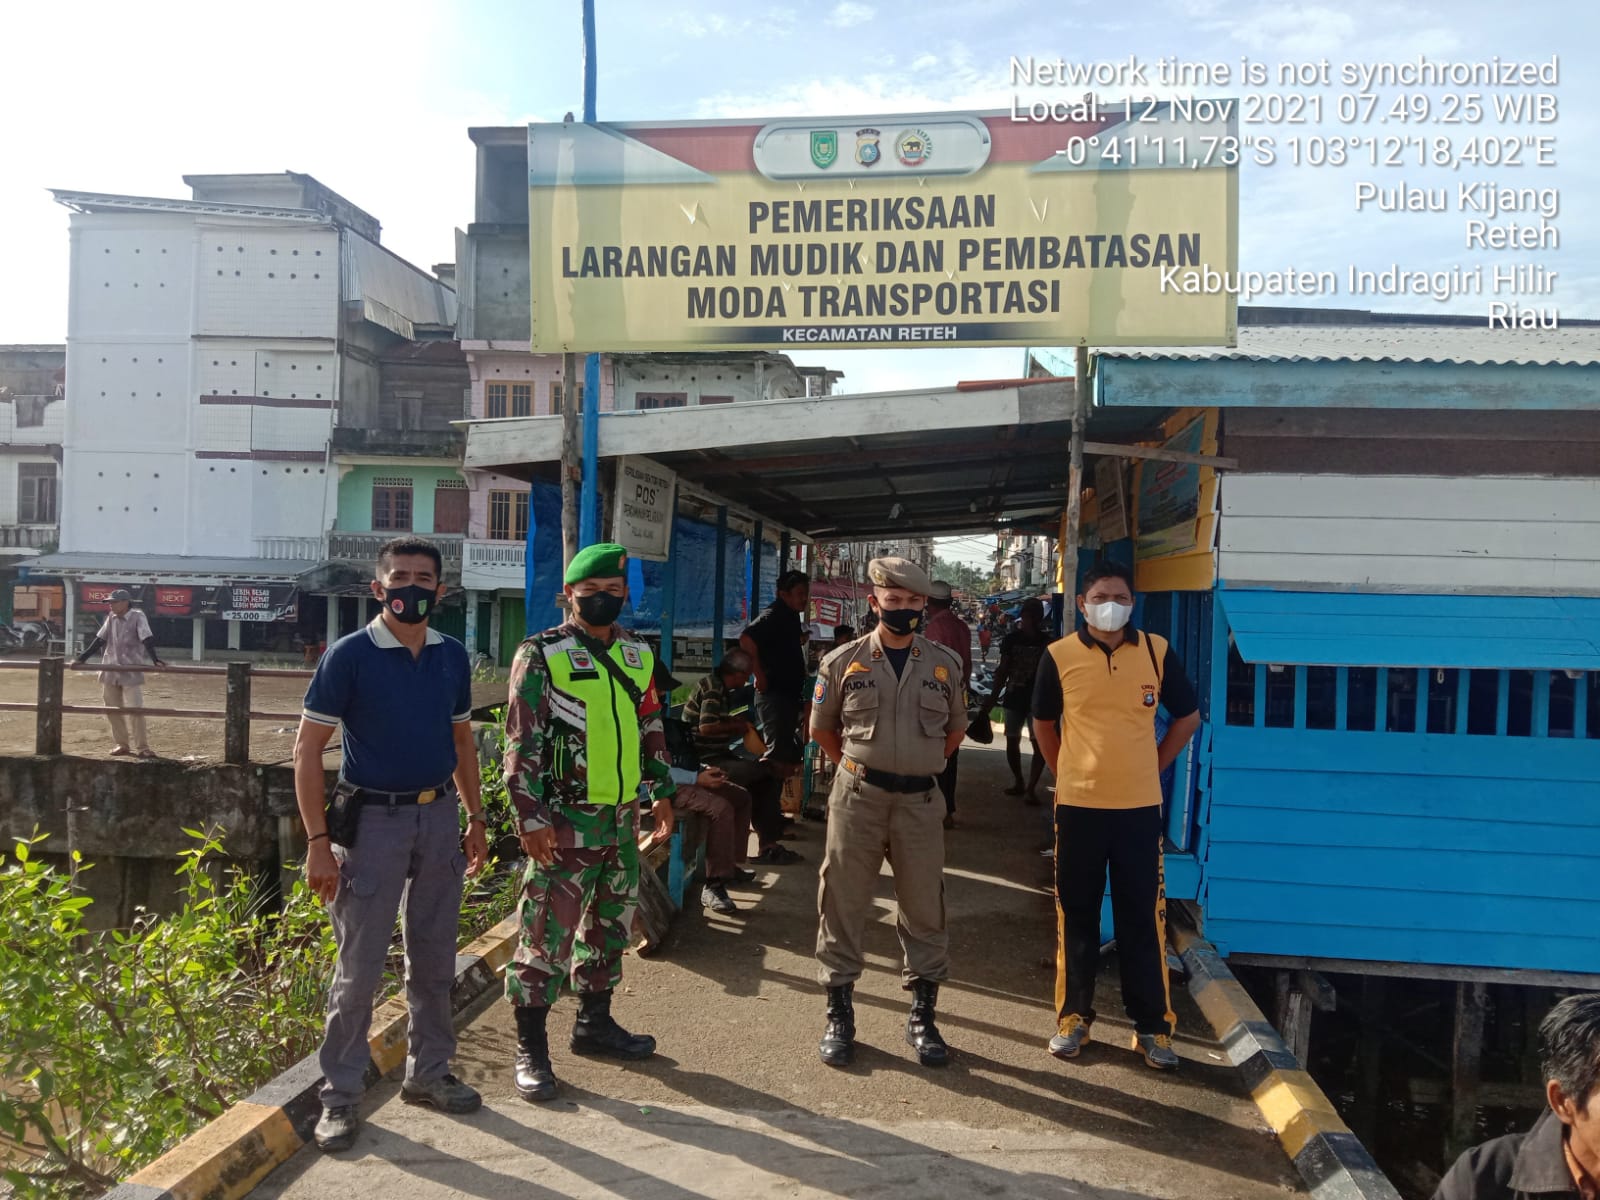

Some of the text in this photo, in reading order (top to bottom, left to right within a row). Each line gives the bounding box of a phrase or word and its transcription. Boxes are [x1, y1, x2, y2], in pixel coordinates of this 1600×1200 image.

[748, 195, 996, 234] PEMERIKSAAN
[561, 233, 1203, 279] LARANGAN MUDIK DAN PEMBATASAN
[687, 280, 1062, 319] MODA TRANSPORTASI
[782, 325, 958, 343] KECAMATAN RETEH
[635, 484, 656, 506] POS
[232, 612, 260, 620] 25.000
